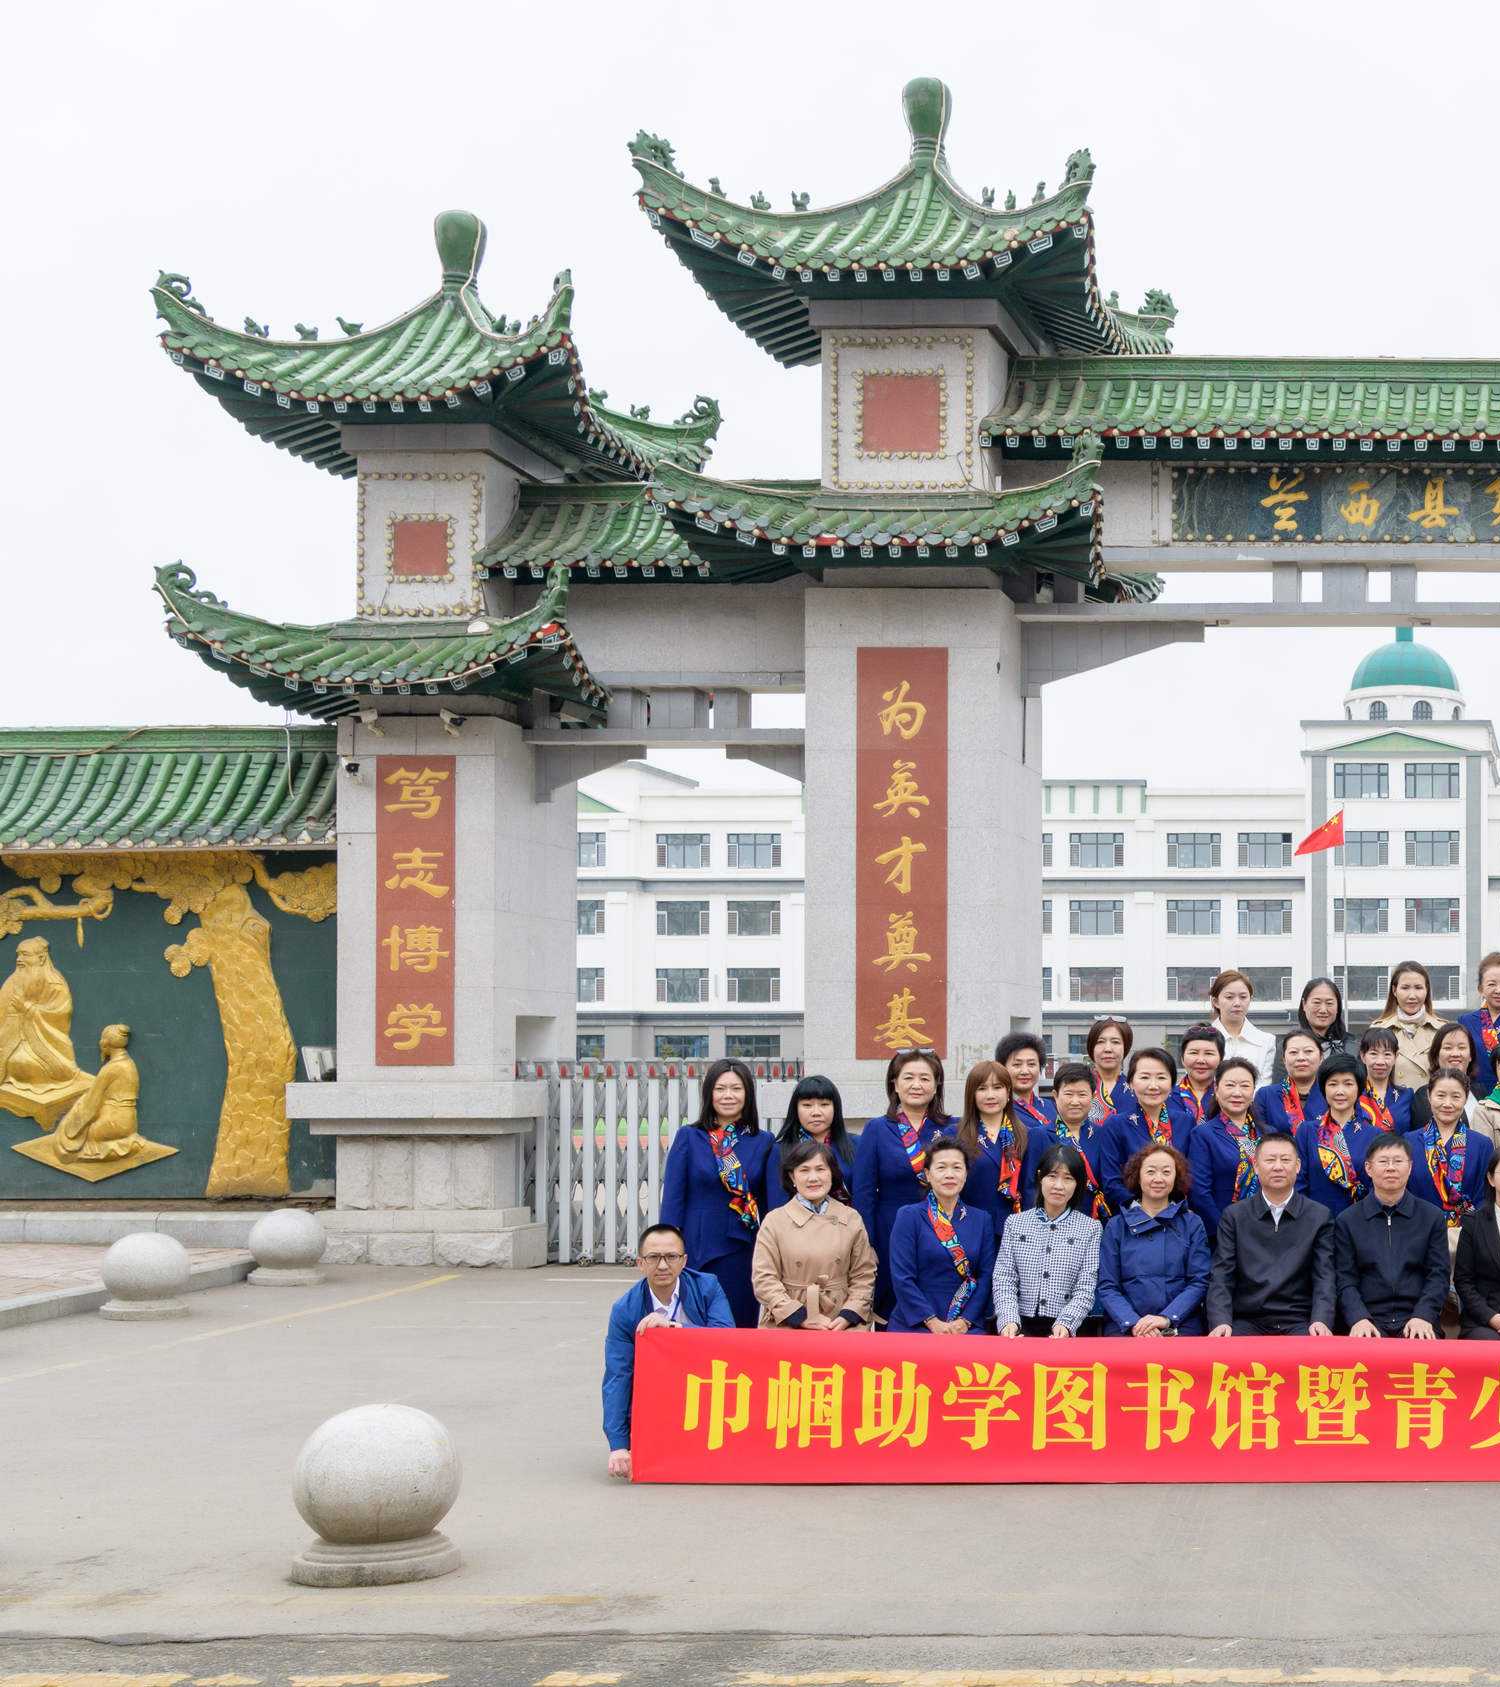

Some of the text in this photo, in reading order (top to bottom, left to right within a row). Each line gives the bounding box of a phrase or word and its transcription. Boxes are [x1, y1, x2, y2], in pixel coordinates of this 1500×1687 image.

[381, 767, 450, 1051] 笃志博学
[872, 679, 934, 1049] 为英才奠基
